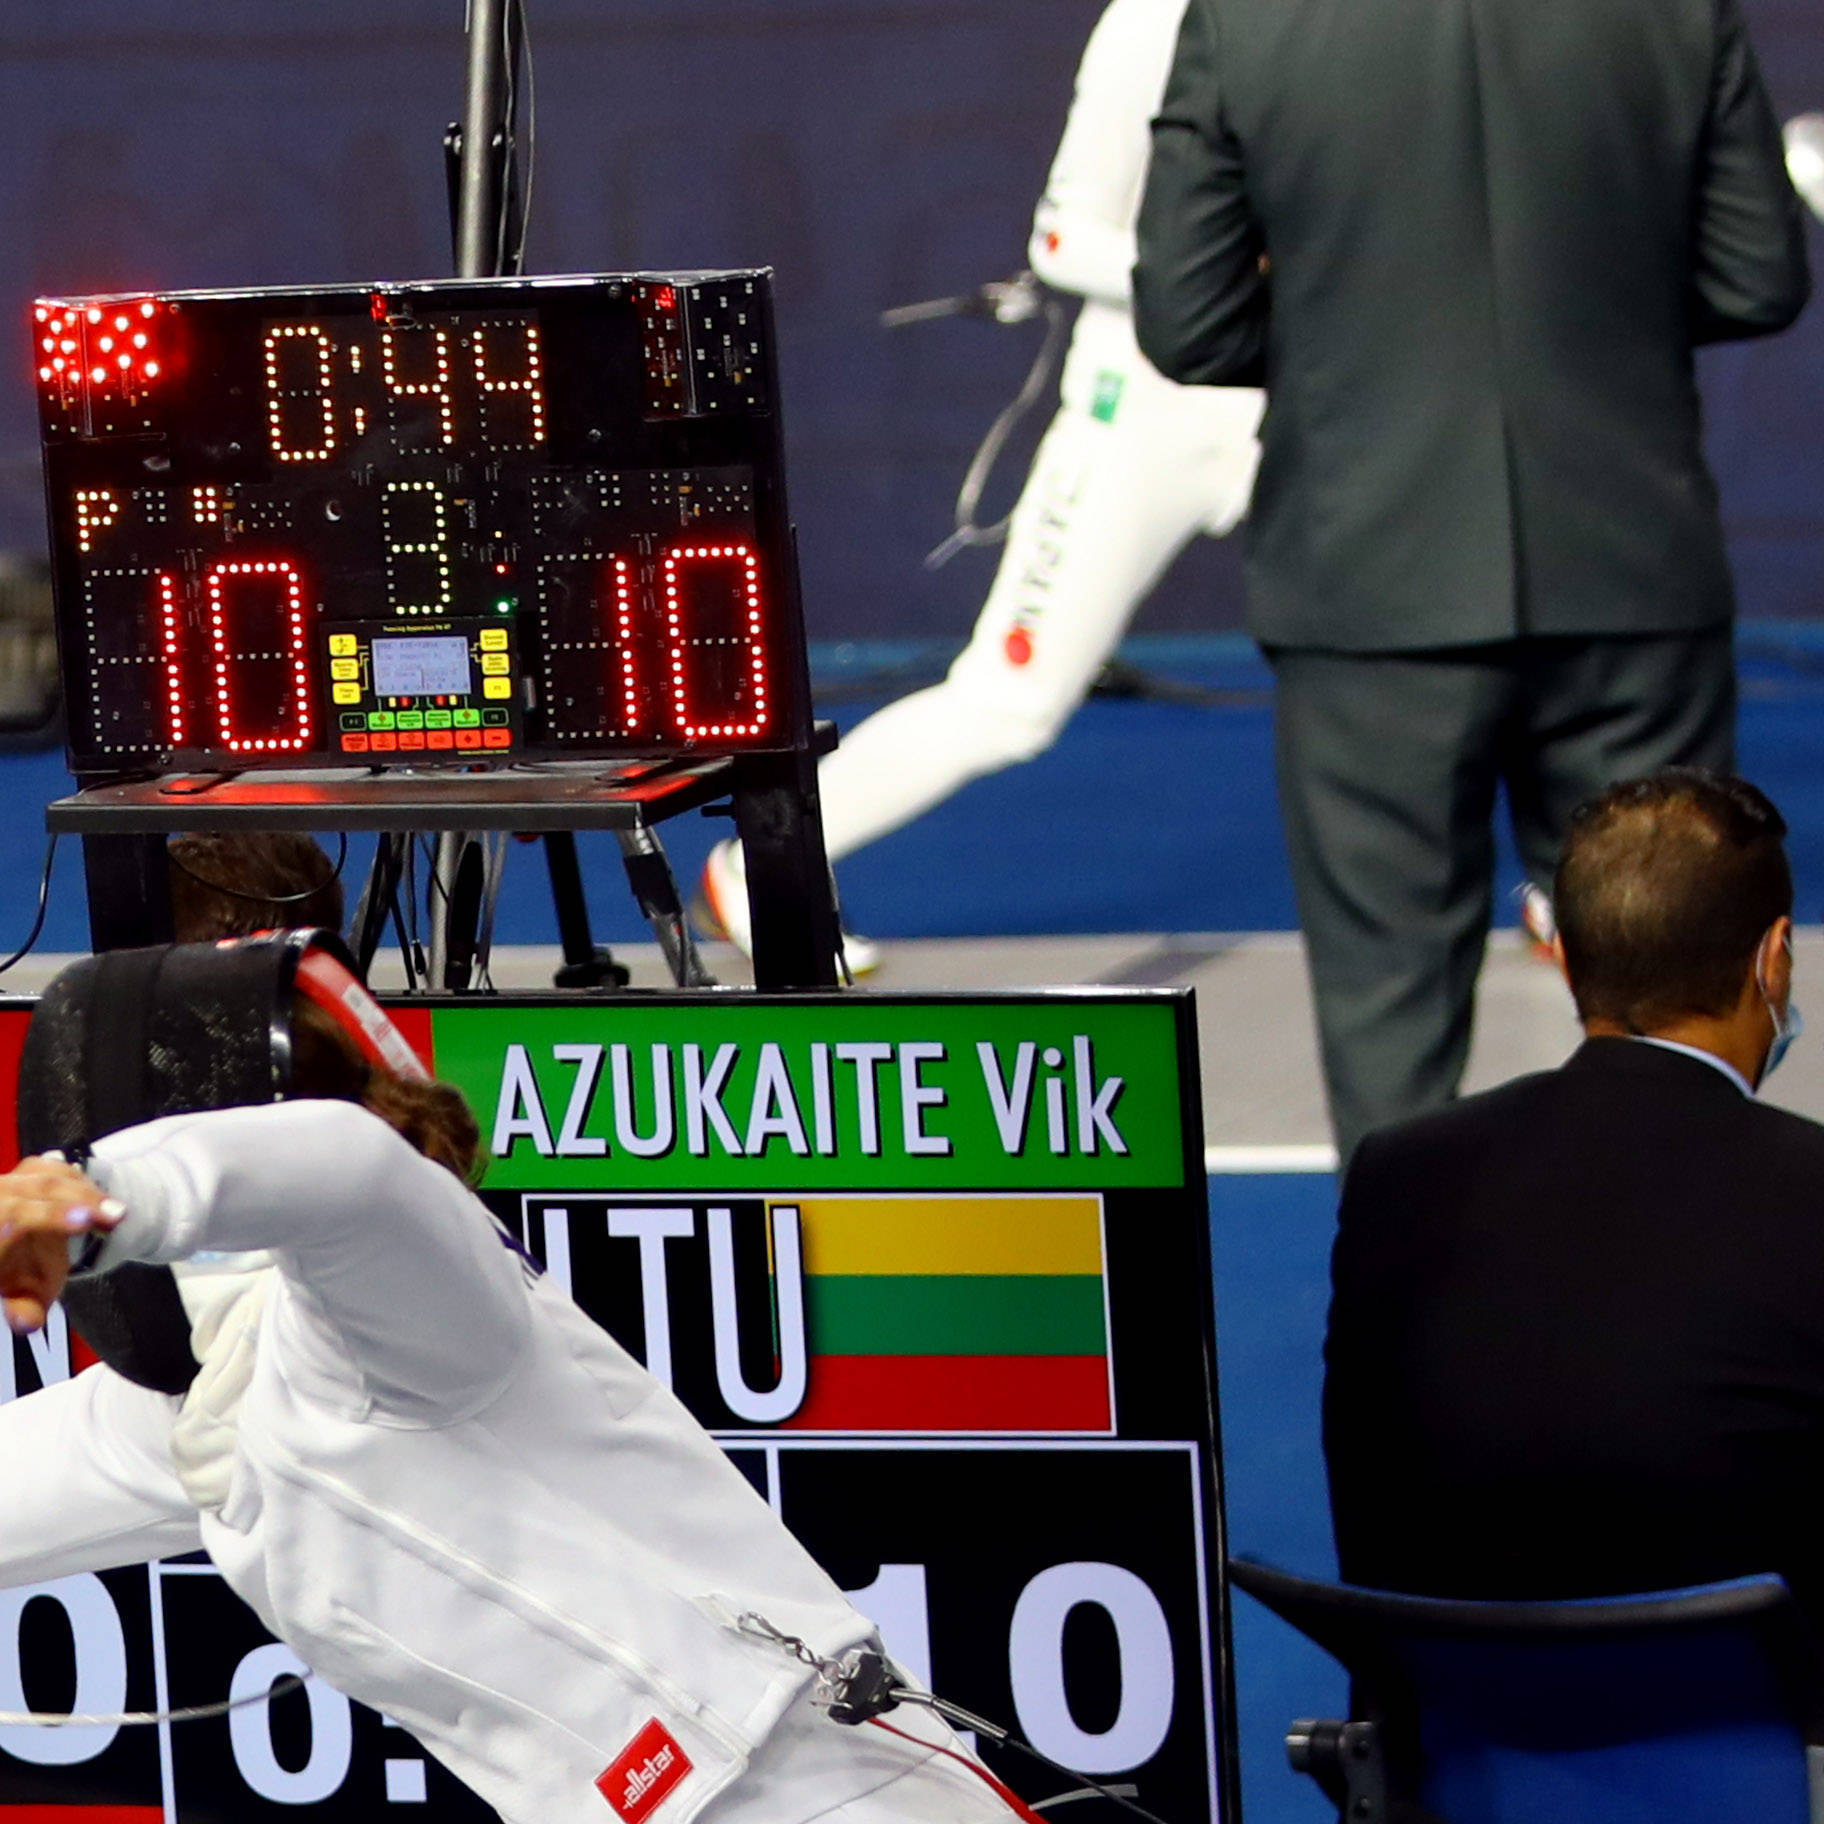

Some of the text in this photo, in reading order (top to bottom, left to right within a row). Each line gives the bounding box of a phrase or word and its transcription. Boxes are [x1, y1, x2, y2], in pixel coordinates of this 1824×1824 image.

[263, 324, 545, 461] 0:44
[159, 562, 310, 751] 10
[614, 546, 767, 737] 10
[490, 1034, 1129, 1158] AZUKAITE Vik
[621, 1743, 675, 1807] allstar
